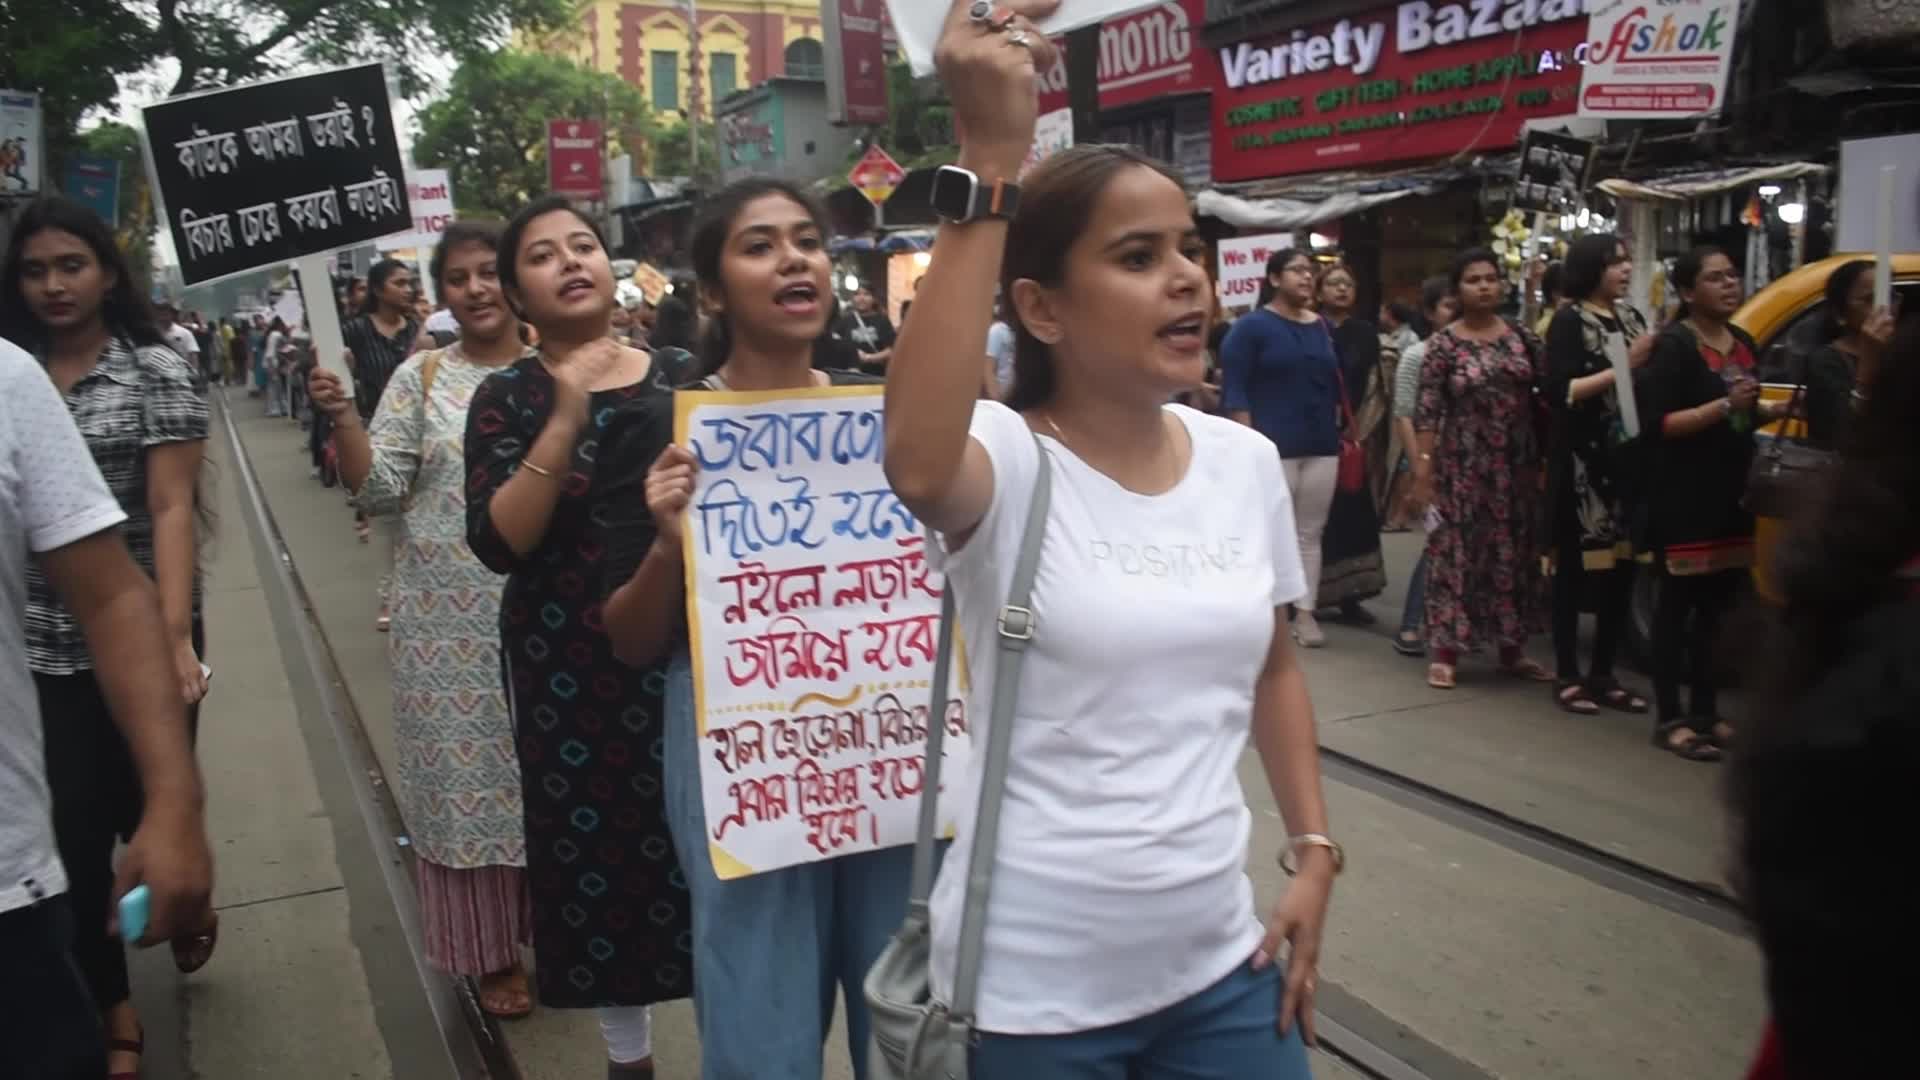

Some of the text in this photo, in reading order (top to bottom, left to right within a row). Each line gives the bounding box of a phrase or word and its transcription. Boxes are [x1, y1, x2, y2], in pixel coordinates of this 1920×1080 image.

[1220, 0, 1590, 88] Variety Bazaa
[1590, 6, 1727, 64] Ashok
[1414, 65, 1473, 94] HOME
[173, 121, 240, 178] কাউকে
[243, 115, 304, 160] আমরা
[180, 208, 235, 260] বিচার
[236, 201, 283, 247] চেয়ে
[283, 184, 342, 231] করবো
[1222, 249, 1248, 267] We
[1223, 276, 1266, 296] JUST
[695, 474, 827, 559] দিতেই
[717, 560, 827, 624] নইলে
[857, 613, 942, 671] হবে
[706, 719, 767, 774] হাল
[712, 754, 947, 841] এবার বিচার হতে
